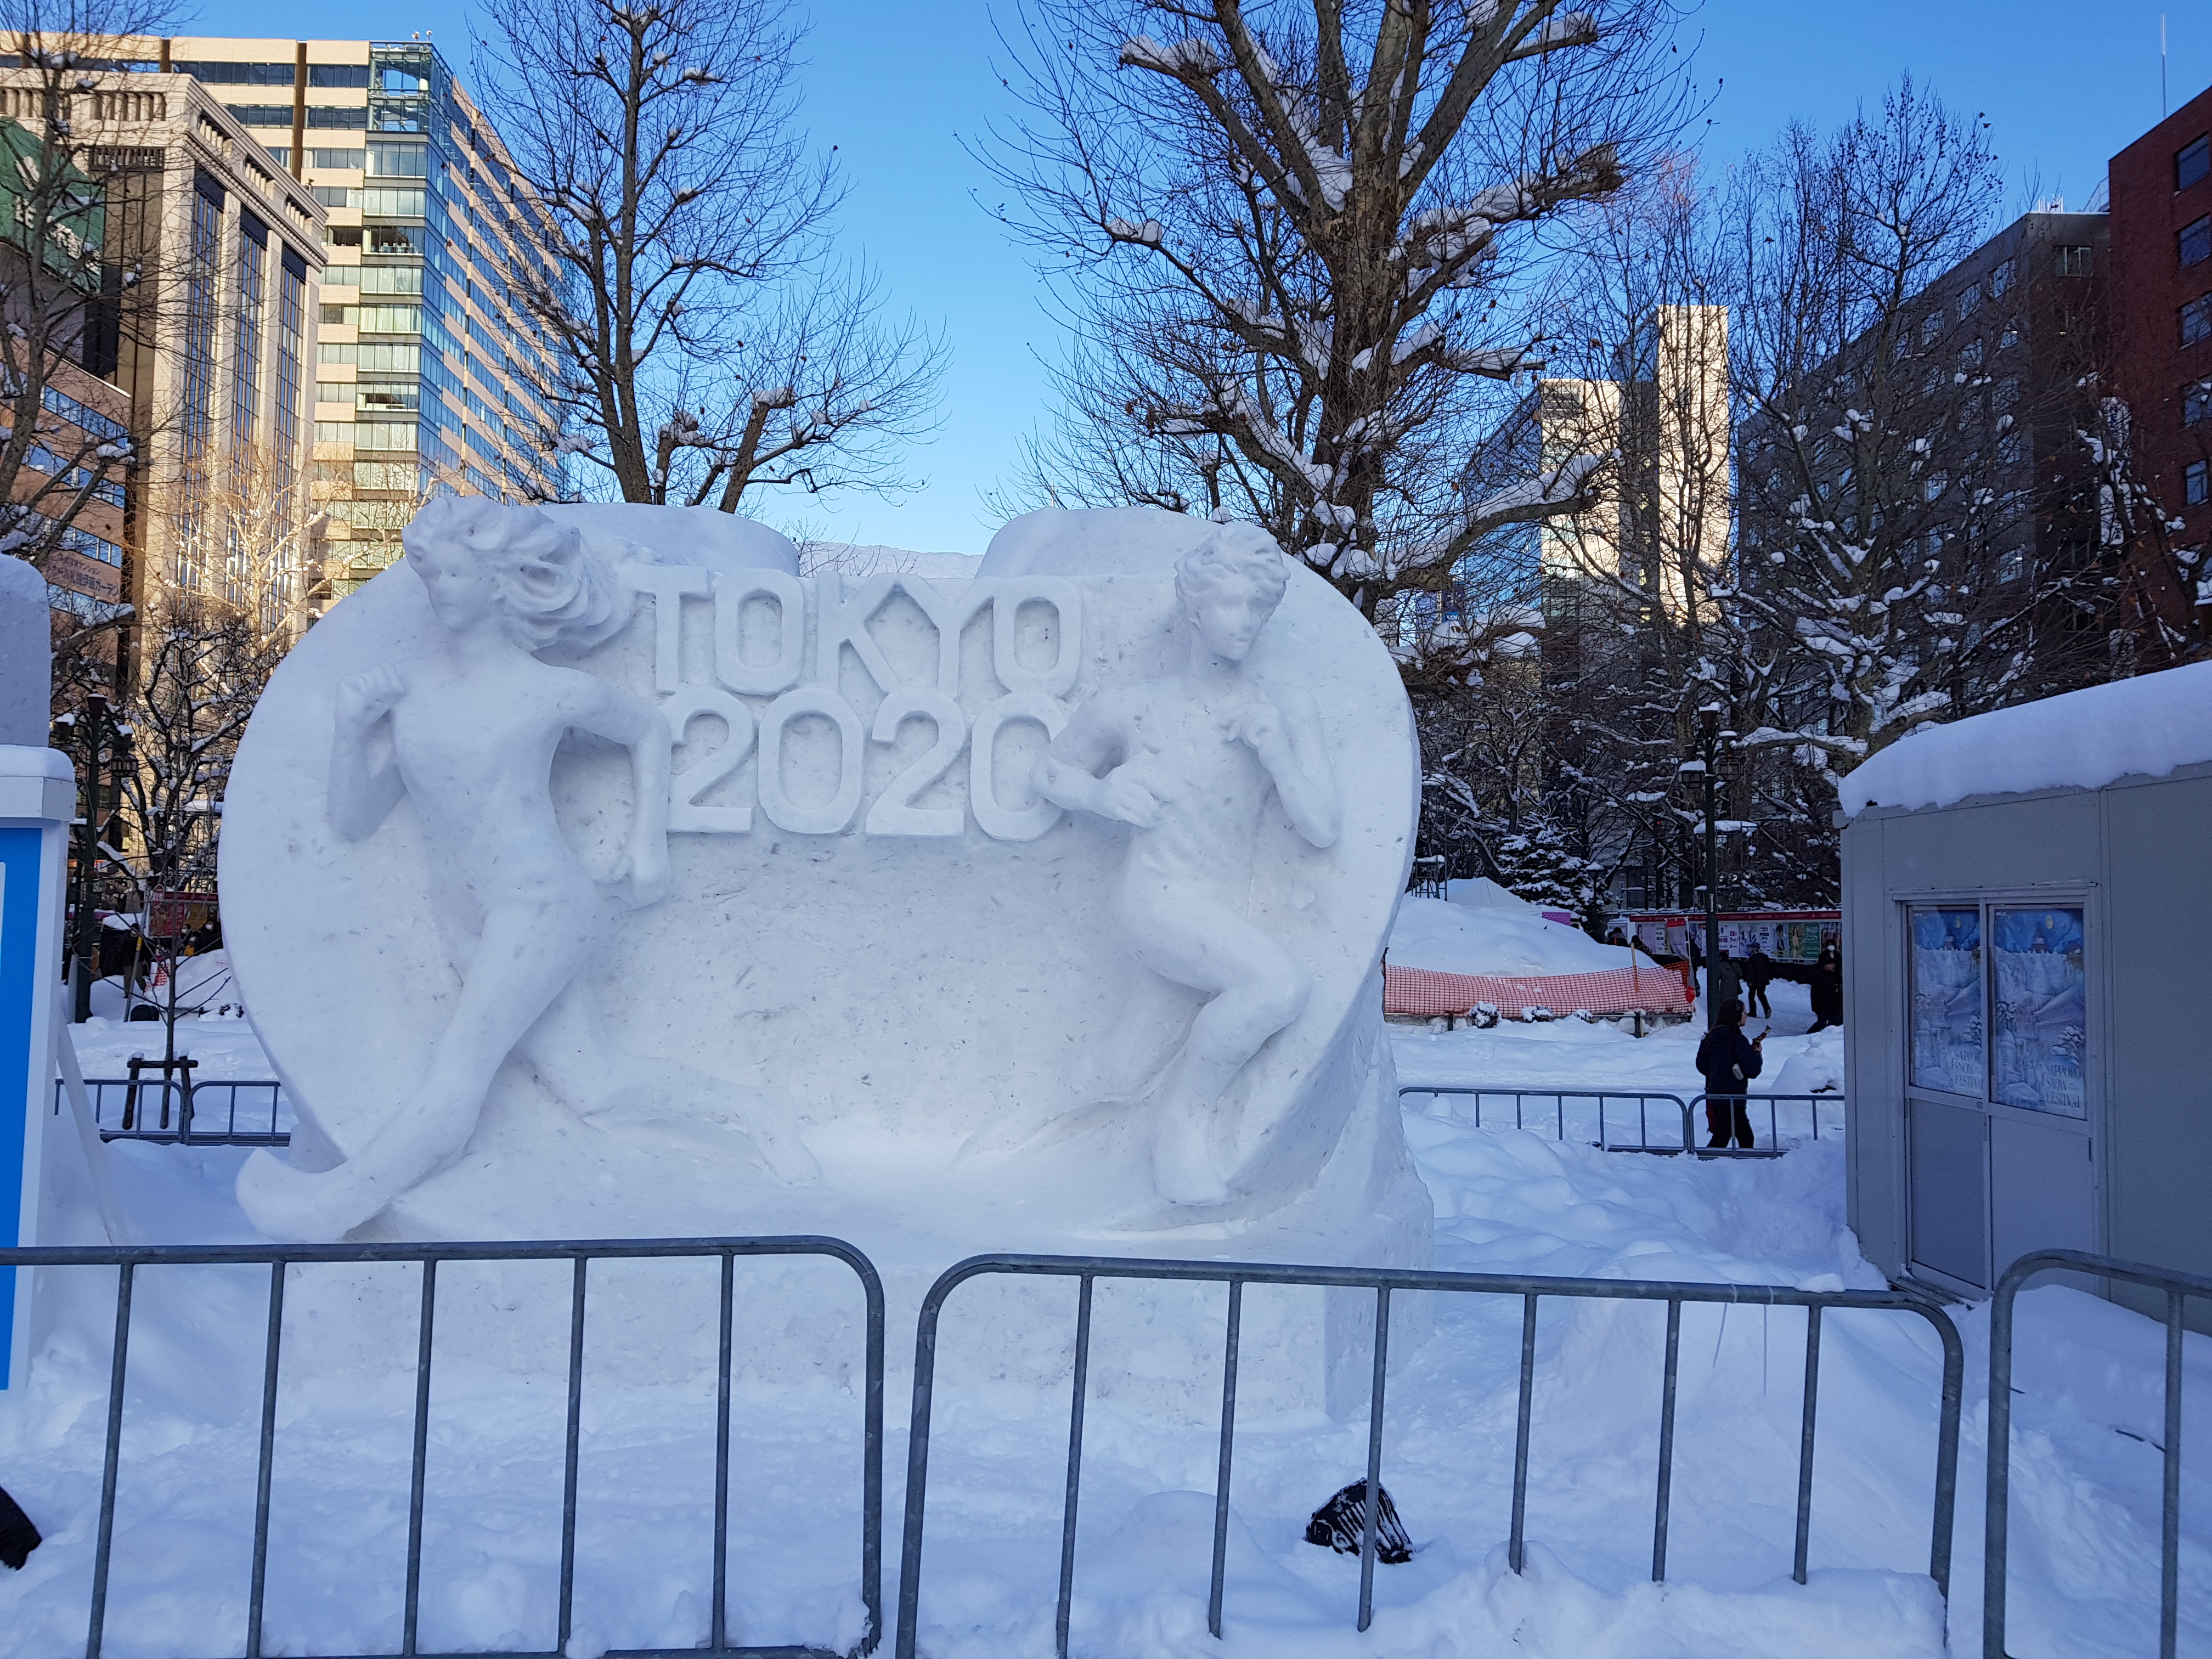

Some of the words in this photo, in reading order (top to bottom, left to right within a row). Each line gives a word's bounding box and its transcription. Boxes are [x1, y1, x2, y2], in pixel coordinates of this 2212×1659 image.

[631, 567, 1082, 698] TOKYO
[663, 687, 1069, 842] 2020
[2046, 1064, 2081, 1080] SAPPORO
[2046, 1077, 2067, 1091] SNOW
[2046, 1091, 2081, 1108] FESTIVAL
